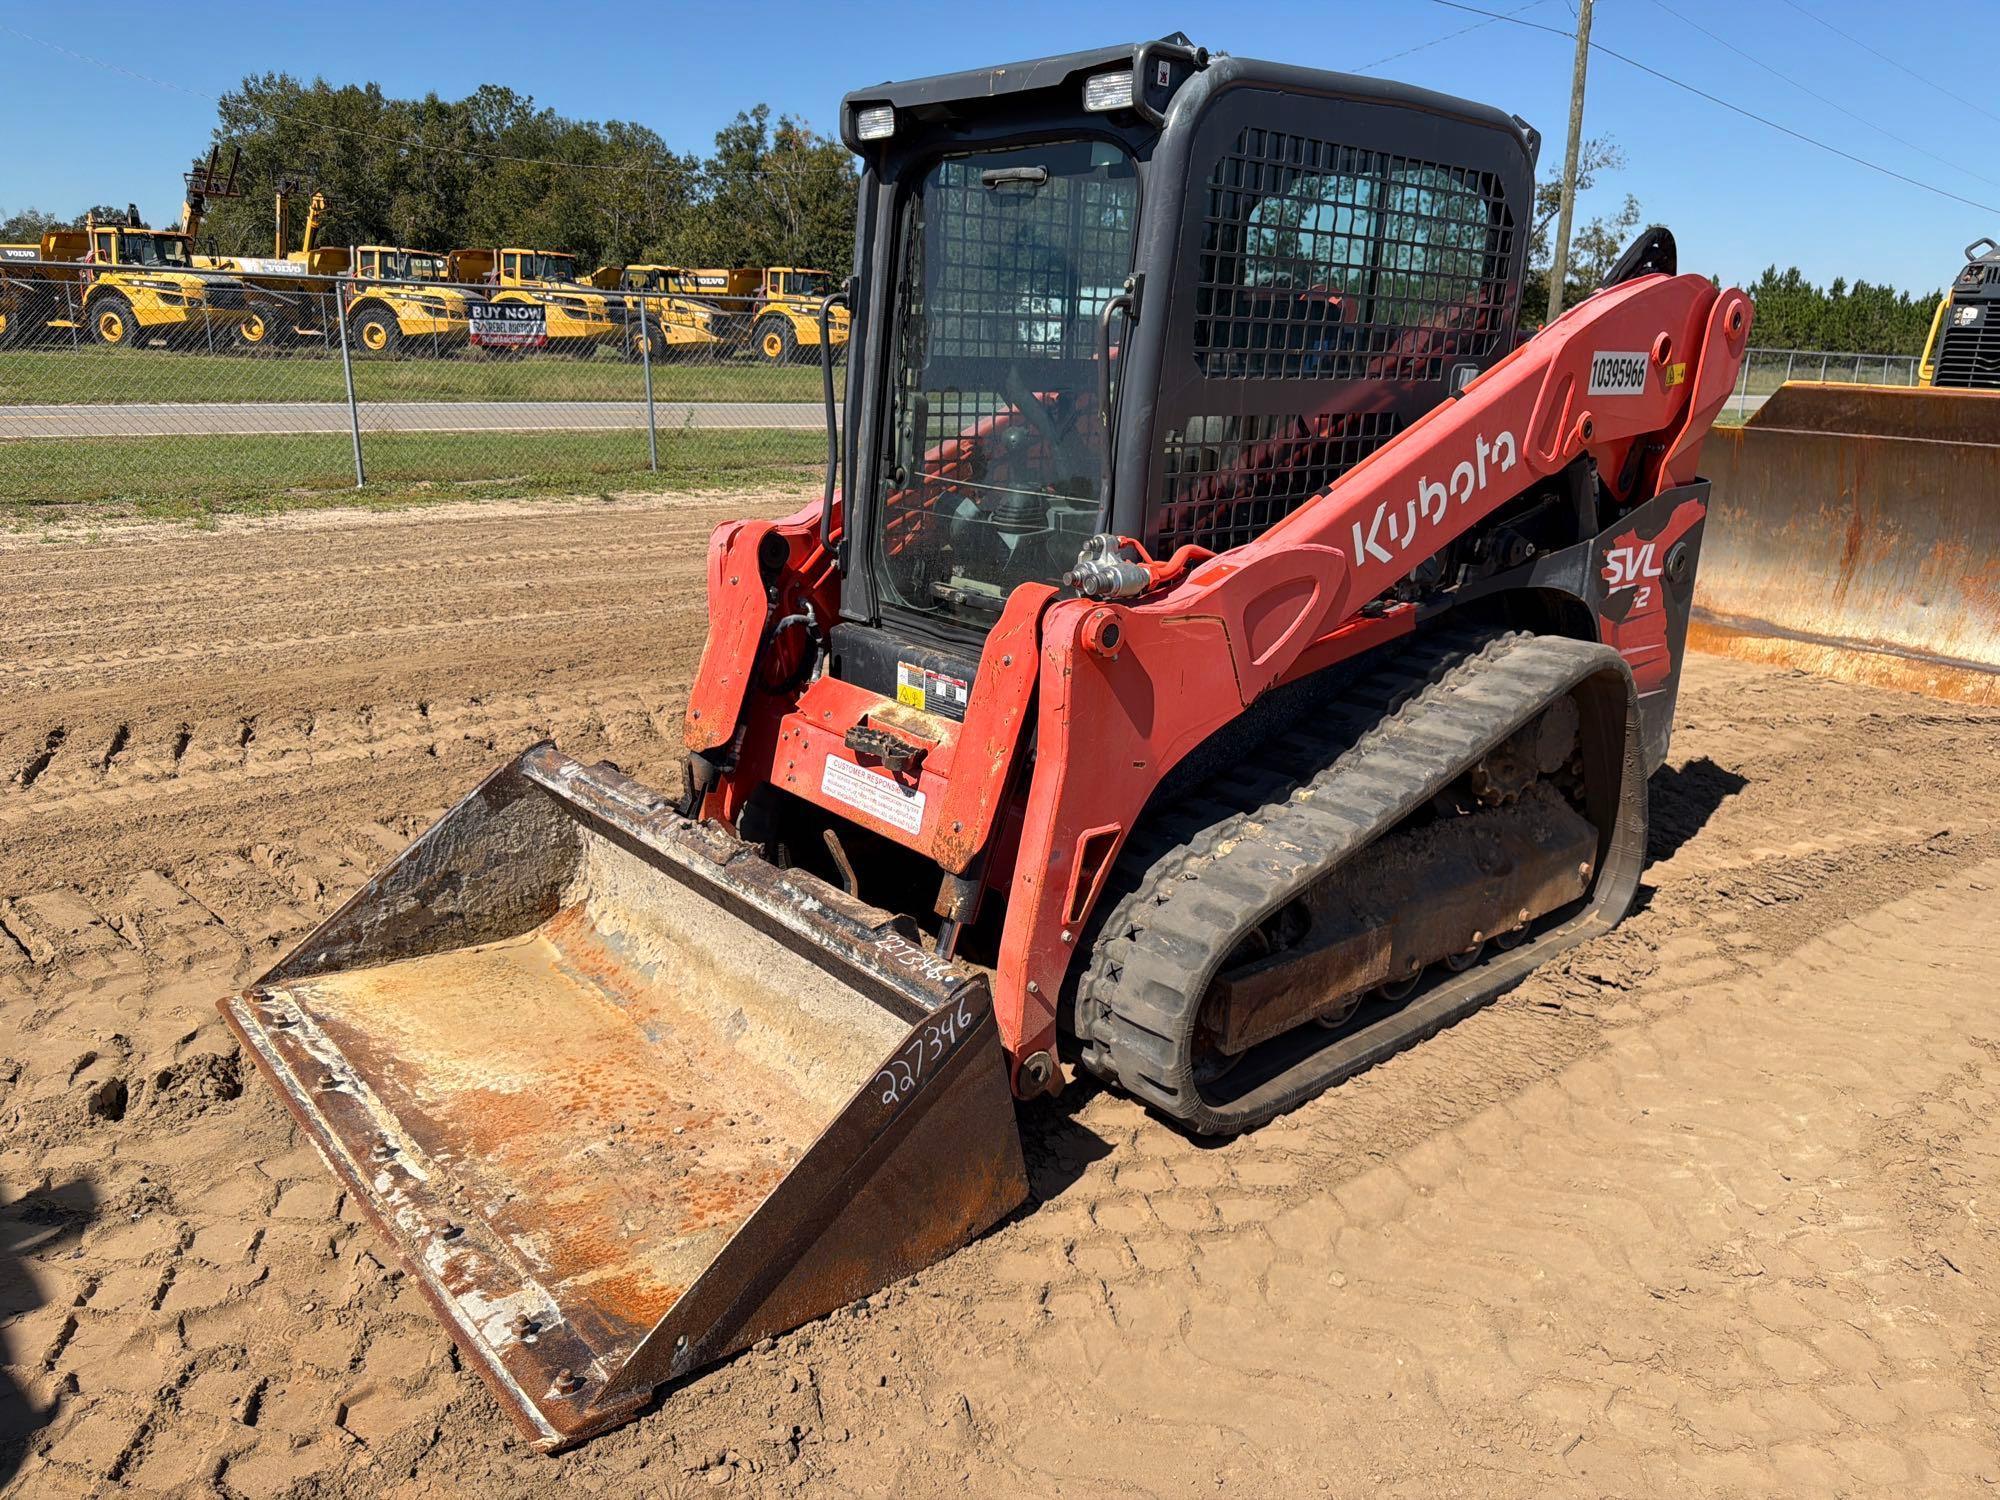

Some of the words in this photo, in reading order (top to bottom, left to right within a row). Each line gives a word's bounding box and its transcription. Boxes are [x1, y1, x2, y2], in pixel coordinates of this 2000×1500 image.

[267, 264, 302, 273] VOLVO
[472, 305, 501, 319] BUY
[506, 306, 542, 319] NOW
[1591, 358, 1645, 388] 10395966
[1352, 431, 1516, 567] Kubota
[1604, 543, 1662, 585] SVL
[833, 758, 866, 779] CUSTOMER
[876, 998, 972, 1104] 227346
